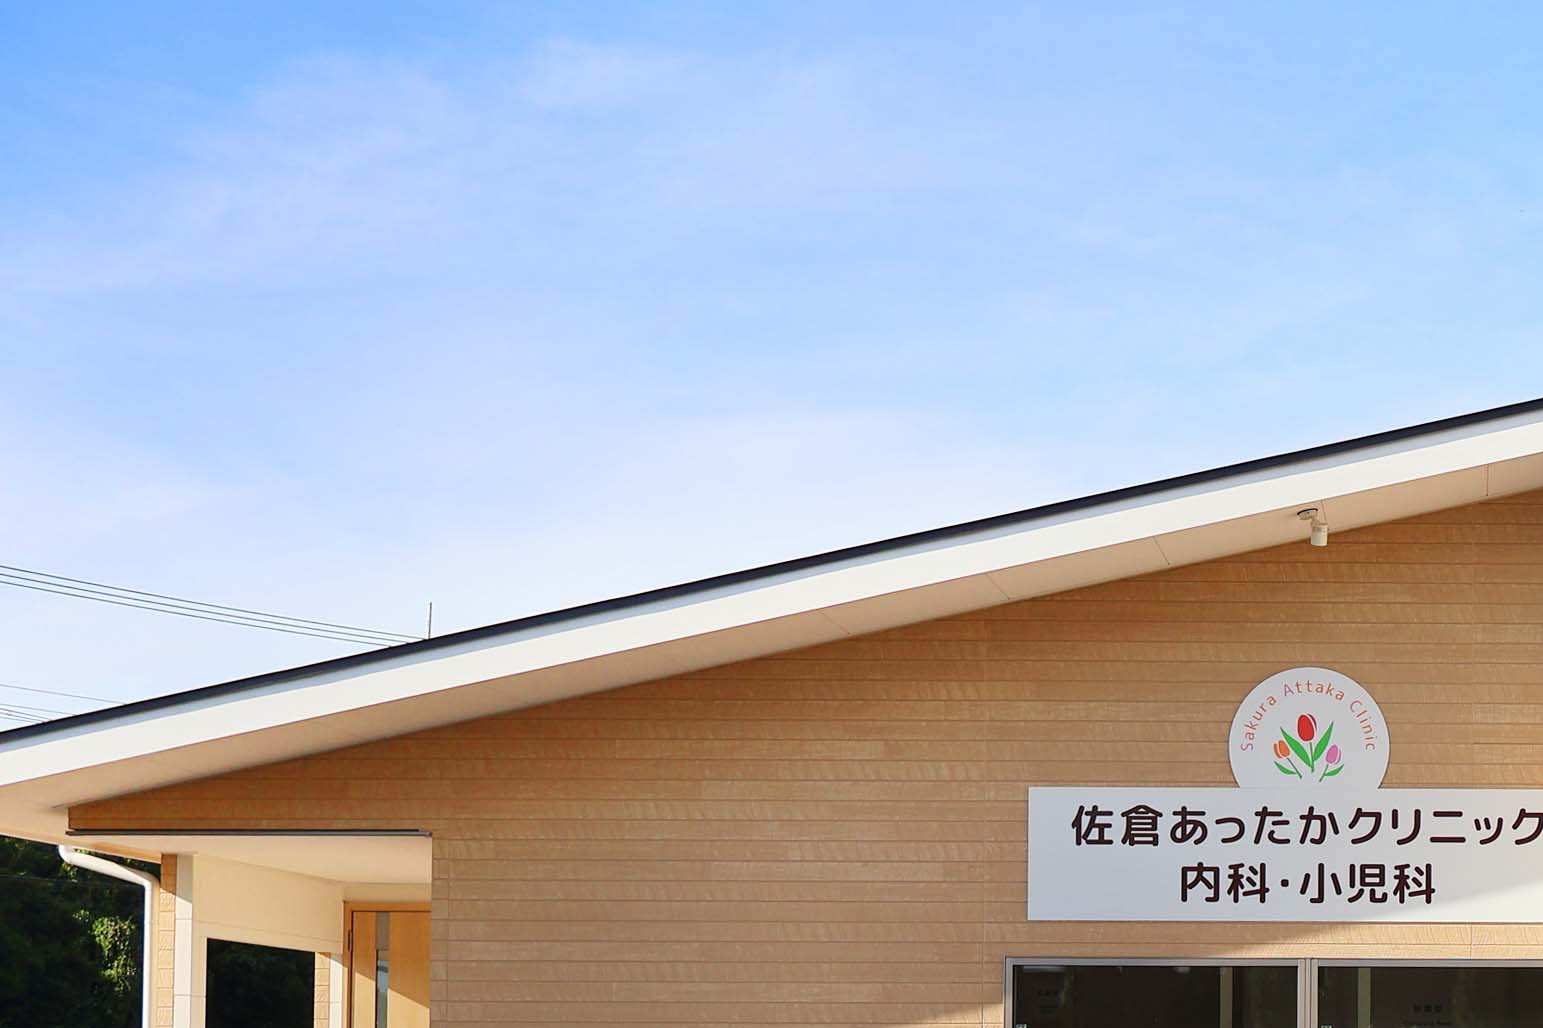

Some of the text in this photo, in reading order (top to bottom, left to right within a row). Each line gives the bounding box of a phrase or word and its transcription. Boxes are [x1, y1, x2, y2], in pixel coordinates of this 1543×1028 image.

[1240, 680, 1376, 751] Sakura Attaka Clinic
[1180, 862, 1436, 904] 内科・小児科
